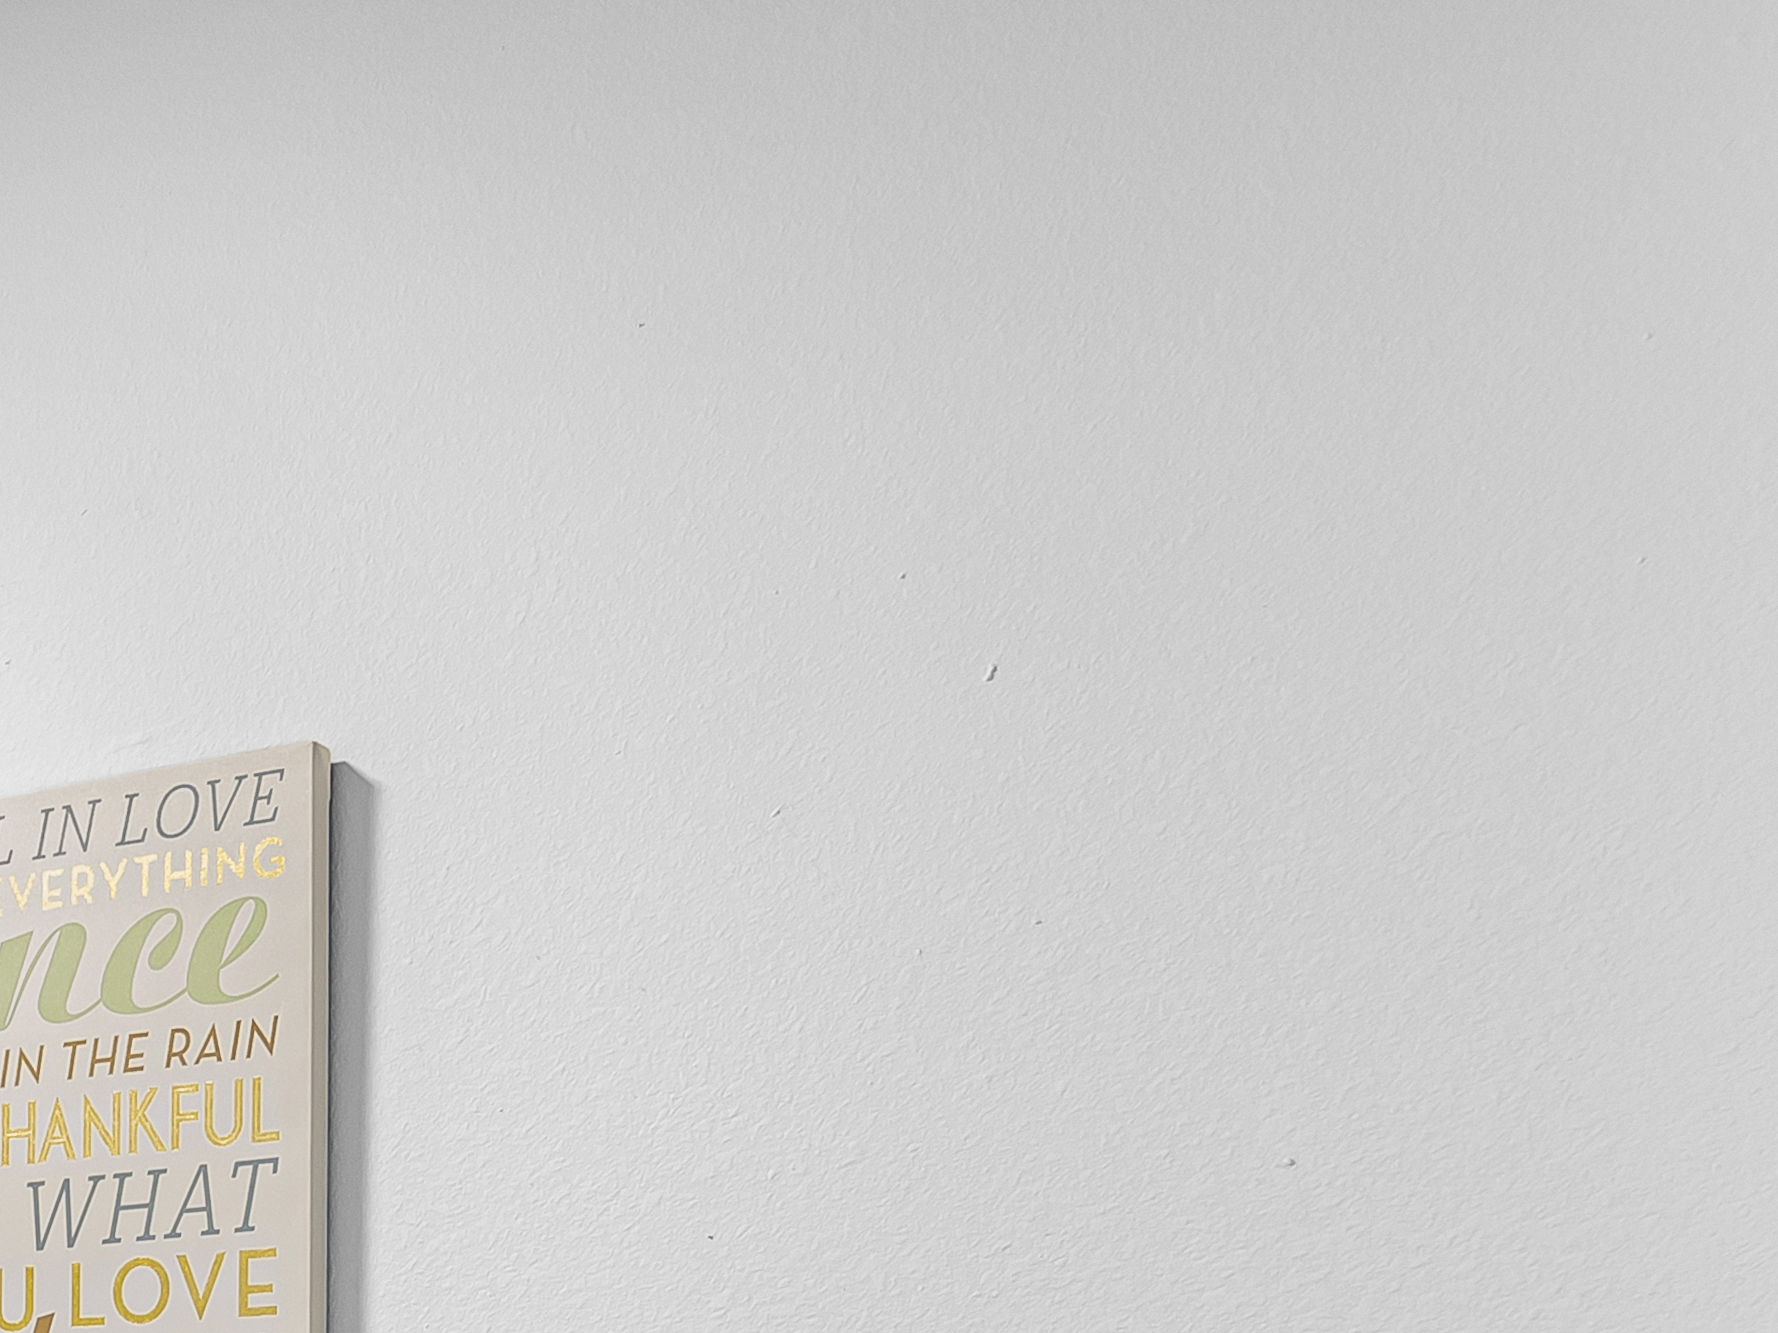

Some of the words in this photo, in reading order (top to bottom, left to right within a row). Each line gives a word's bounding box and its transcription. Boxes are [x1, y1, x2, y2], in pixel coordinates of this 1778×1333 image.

[32, 799, 102, 861] IN
[115, 767, 286, 848] LOVE
[0, 1044, 45, 1089] IN
[62, 1032, 149, 1081] THE
[165, 1015, 281, 1069] RAIN
[26, 1157, 280, 1251] WHAT
[70, 1247, 278, 1327] LOVE
